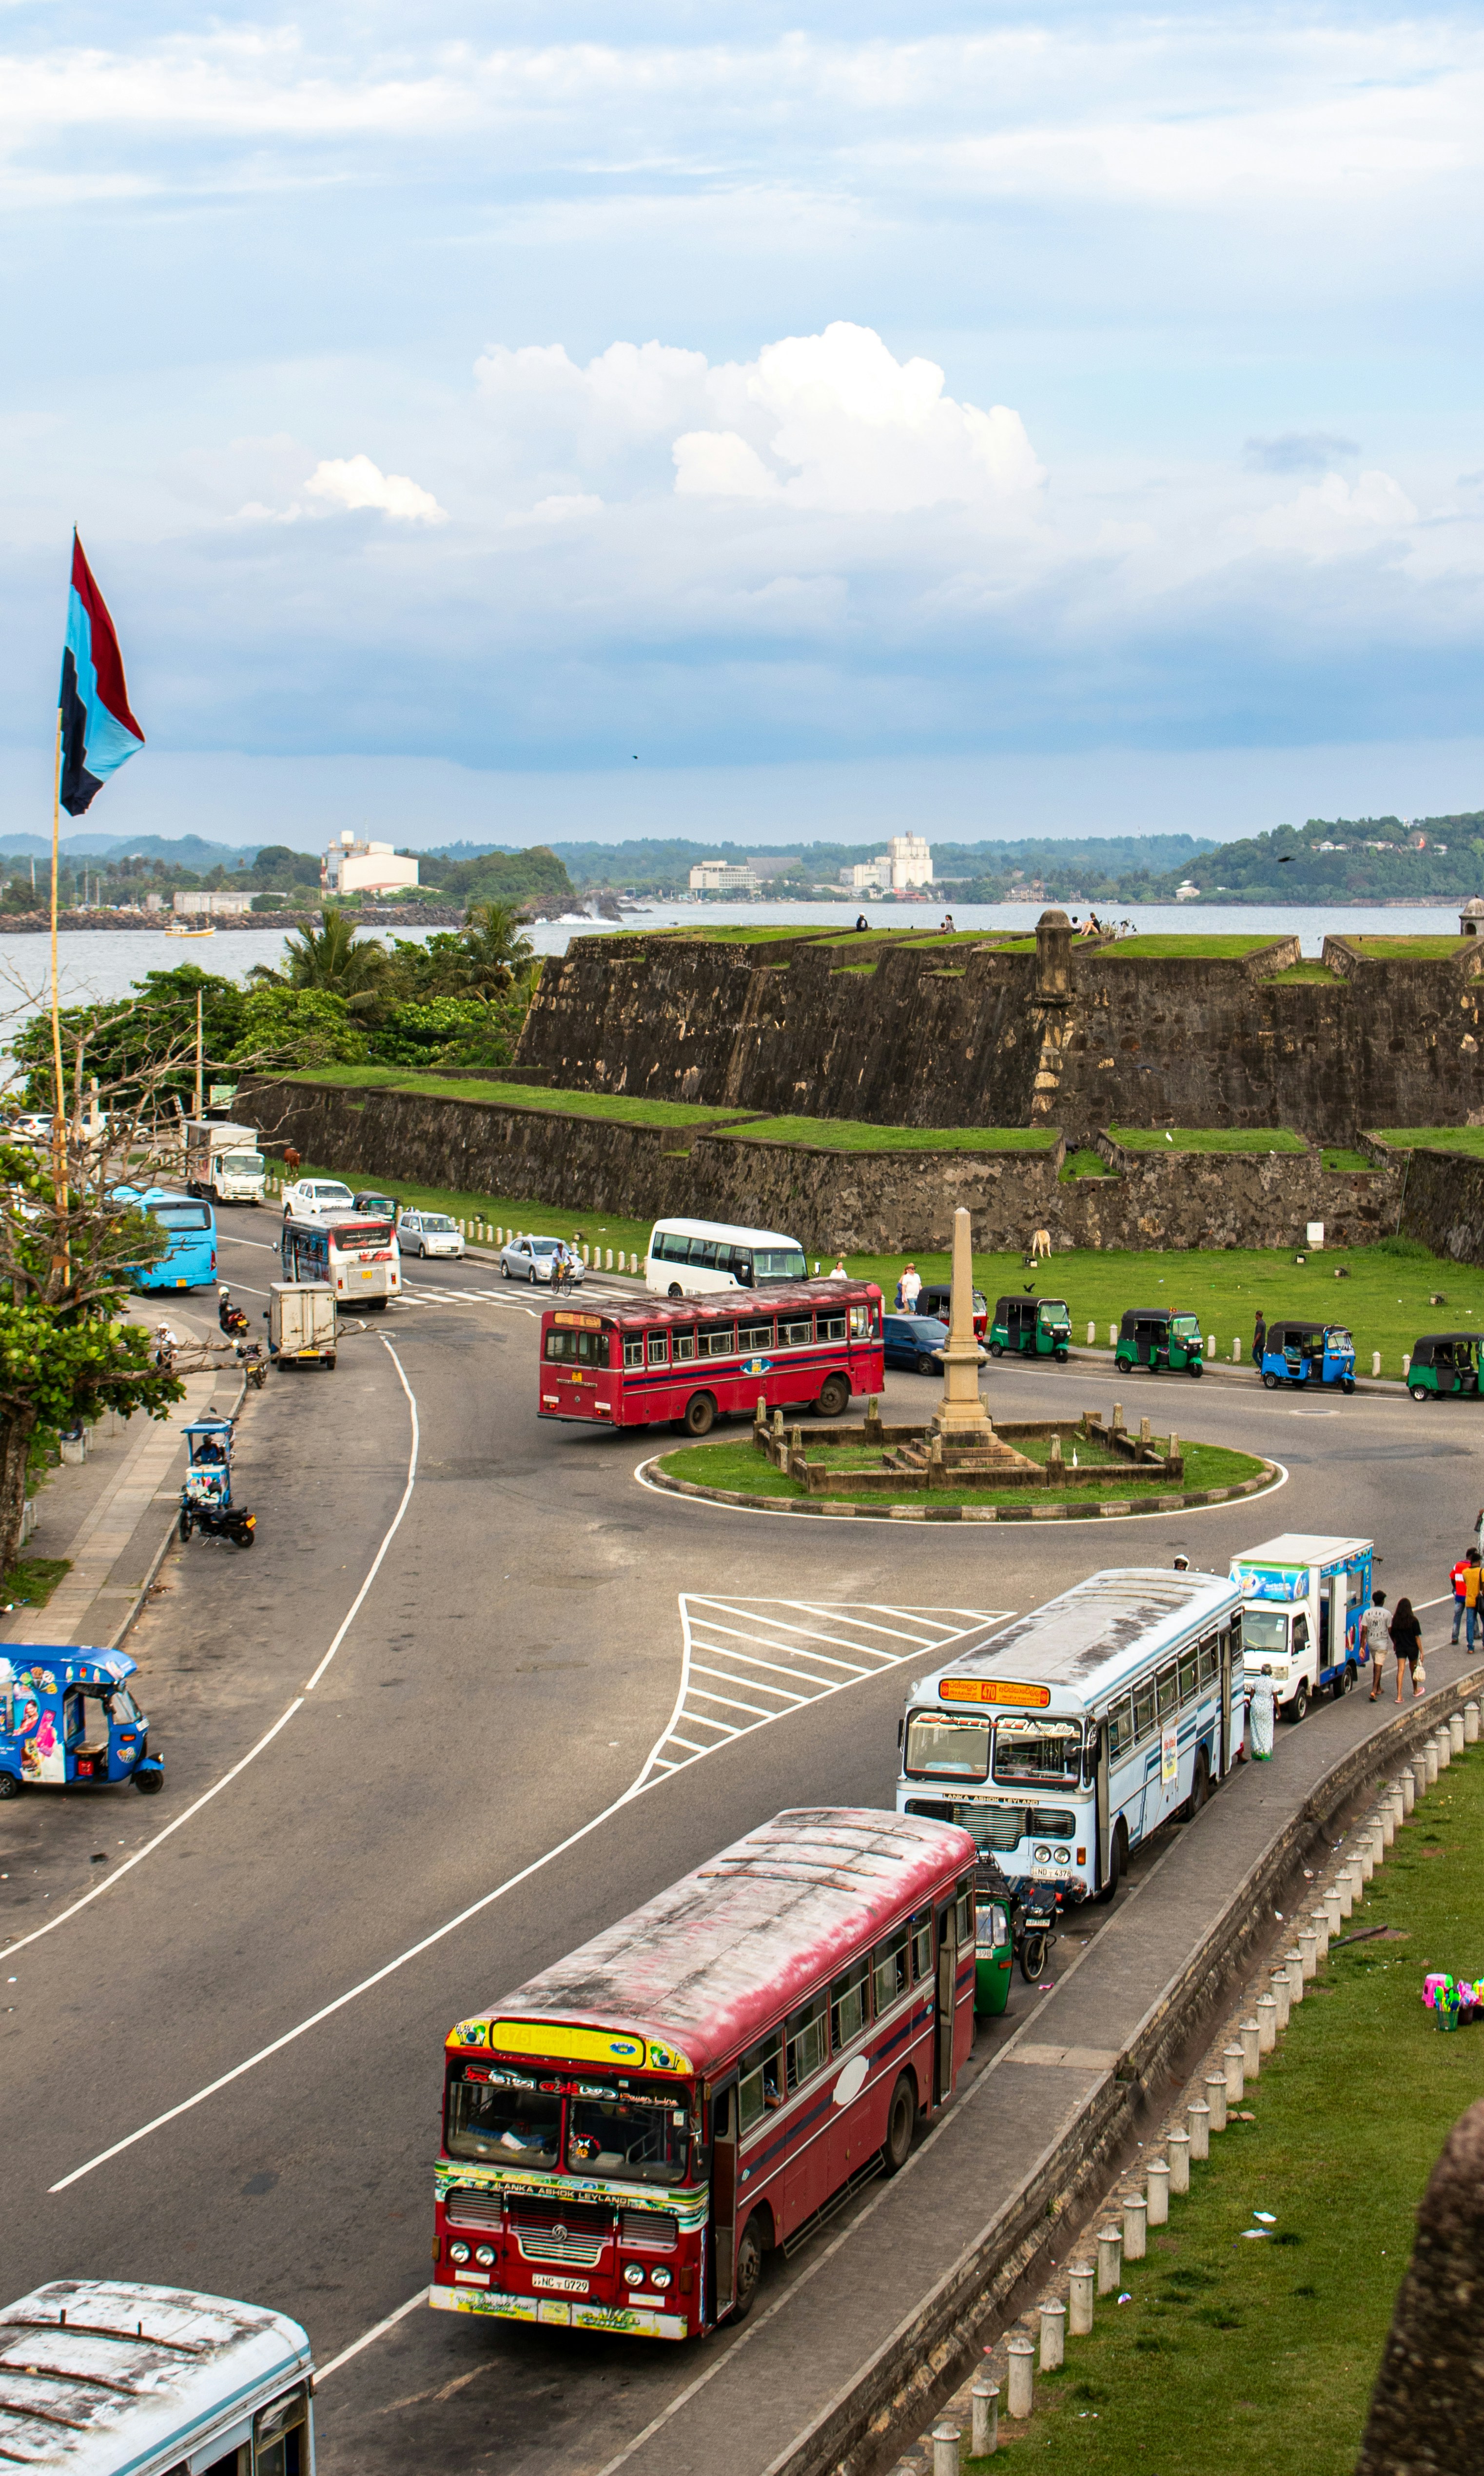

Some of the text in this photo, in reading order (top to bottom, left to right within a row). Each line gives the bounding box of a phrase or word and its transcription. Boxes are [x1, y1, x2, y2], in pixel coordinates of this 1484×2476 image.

[983, 1685, 996, 1699] 470
[501, 2028, 529, 2044] 375
[498, 2182, 628, 2204] LANKA ASHOK LEYLAND
